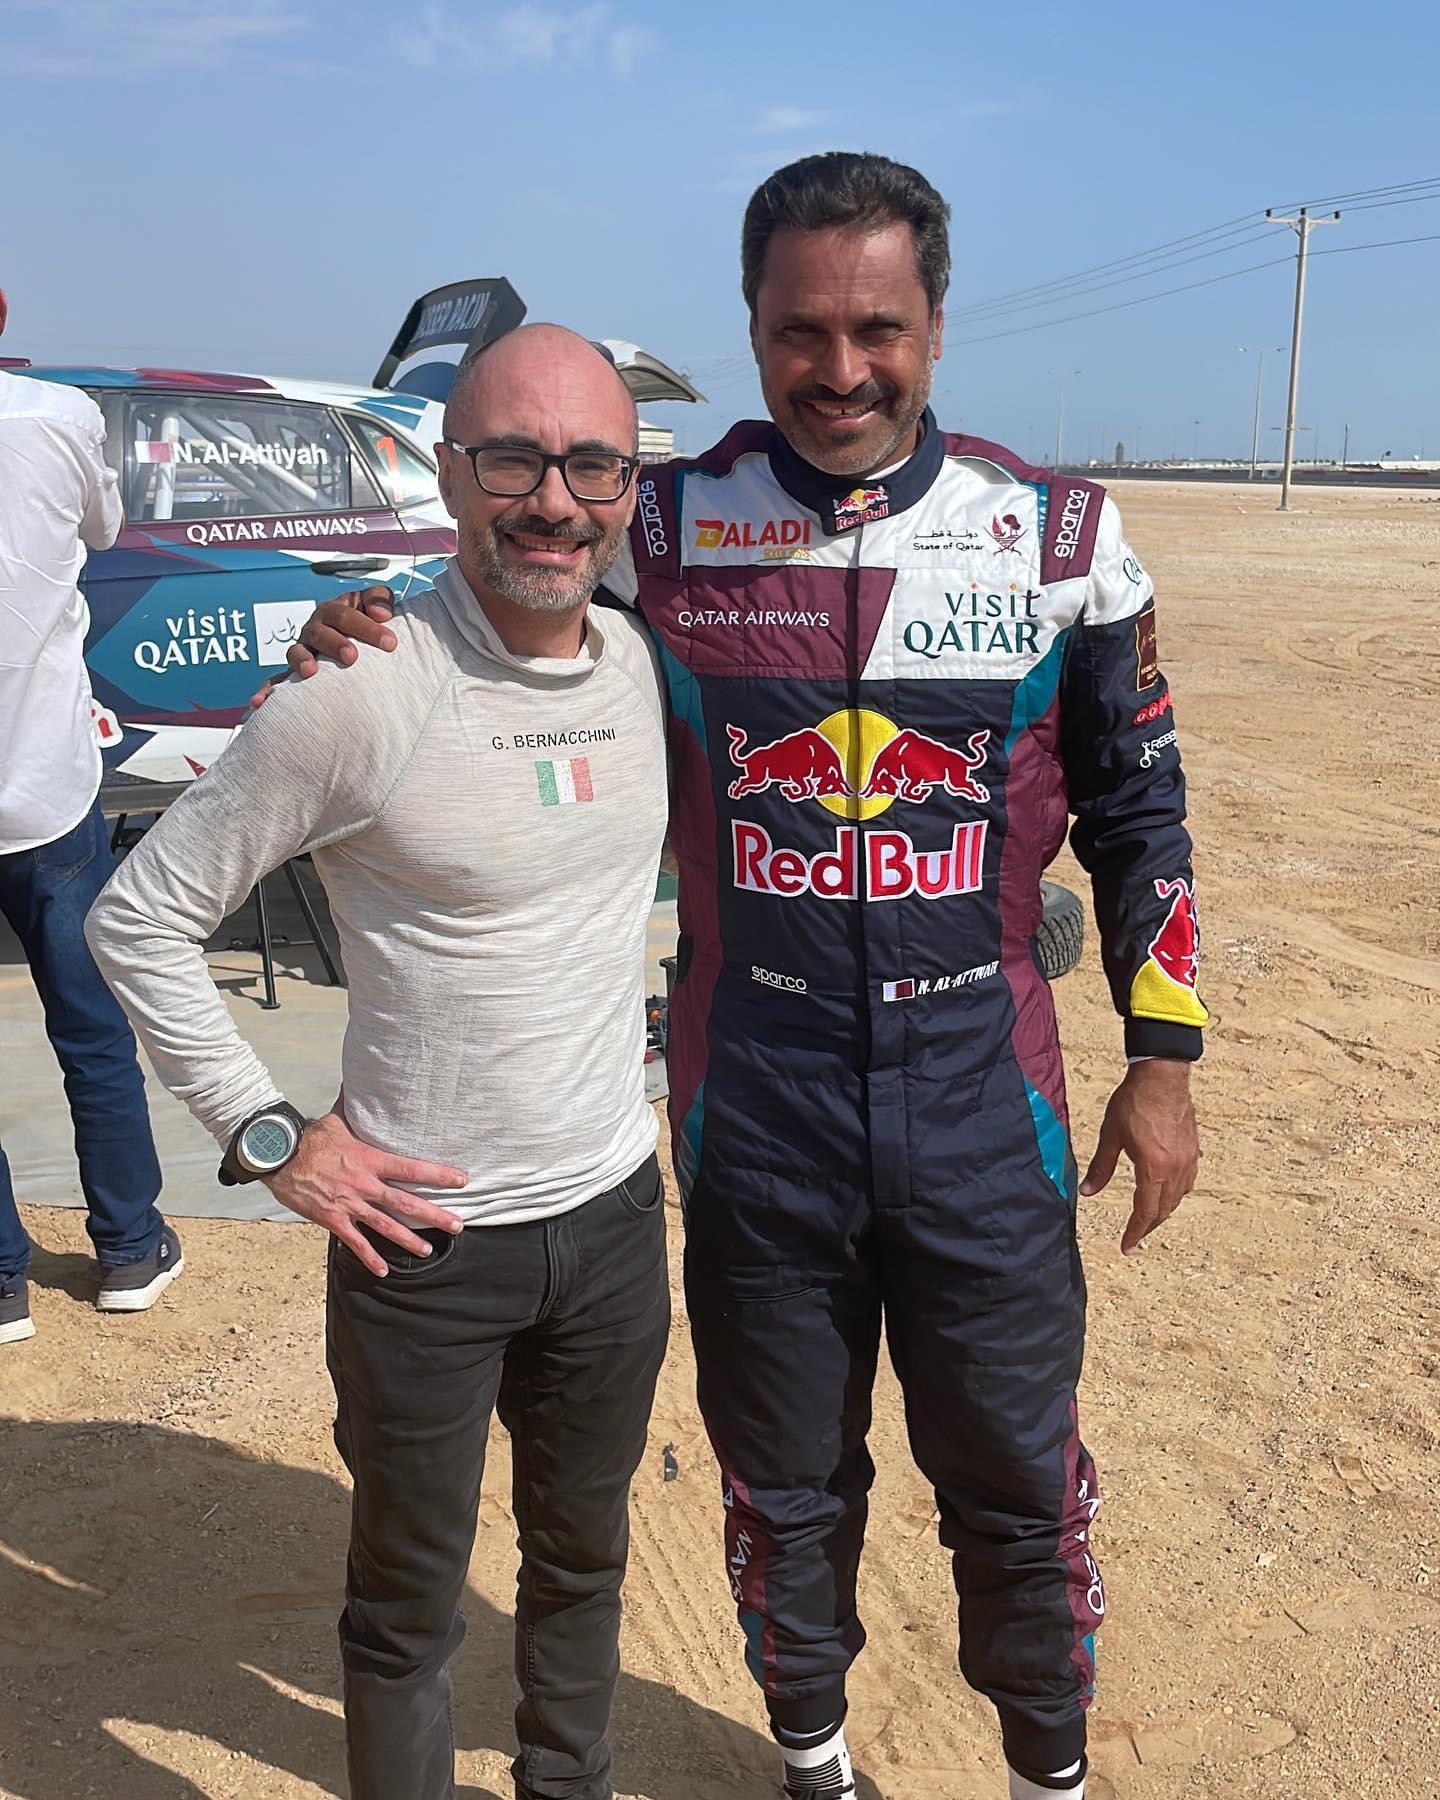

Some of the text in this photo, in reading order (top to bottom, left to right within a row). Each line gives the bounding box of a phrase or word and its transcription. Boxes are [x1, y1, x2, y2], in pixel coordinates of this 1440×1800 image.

[172, 443, 328, 469] N. Al-Attiyah
[376, 435, 405, 503] 1
[186, 517, 368, 546] QATAR AIRWAYS
[637, 480, 669, 558] sparco
[836, 503, 889, 531] Red Bull
[1054, 488, 1088, 560] sparco
[695, 519, 811, 548] BALADI
[913, 542, 985, 552] State of Qatar
[945, 582, 1041, 618] visit
[166, 607, 247, 638] visit
[678, 610, 831, 628] QATAR AIRWAYS
[903, 620, 1041, 659] QATAR
[134, 635, 250, 674] QATAR
[491, 728, 617, 750] G. BERNACCHINI
[731, 819, 989, 903] Red Bull
[752, 965, 807, 993] sparco
[917, 979, 931, 995] N.
